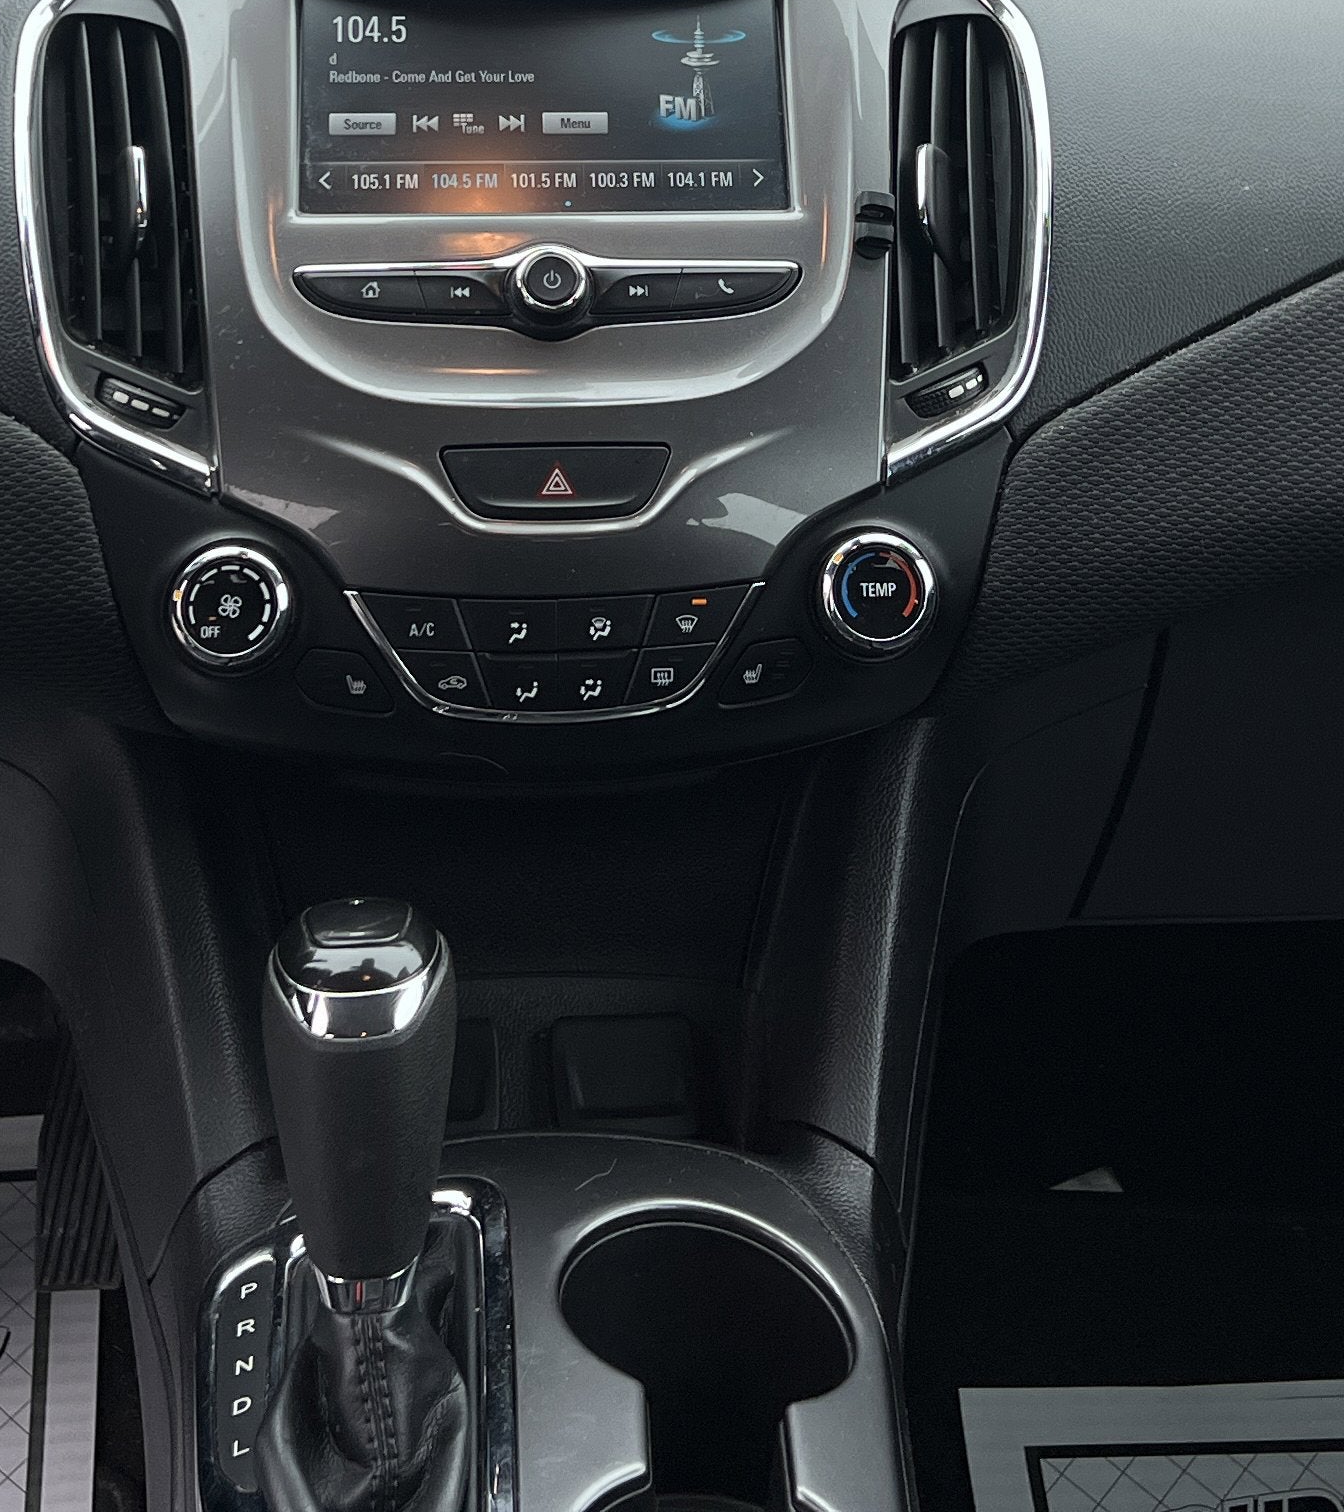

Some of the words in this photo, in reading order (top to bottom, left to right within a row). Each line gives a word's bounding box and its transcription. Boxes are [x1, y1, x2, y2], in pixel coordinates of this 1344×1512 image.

[332, 15, 408, 43] 104.5
[328, 52, 338, 65] d
[329, 70, 381, 83] Redbone
[392, 70, 426, 83] Come
[429, 70, 452, 83] And
[456, 70, 476, 83] Get
[478, 70, 505, 83] Your
[508, 70, 535, 83] Love
[659, 94, 699, 121] FM
[343, 118, 383, 130] Source
[461, 121, 485, 135] Tune
[560, 118, 592, 129] Menu
[351, 173, 392, 189] 105.1
[396, 173, 419, 189] FM
[475, 172, 498, 188] FM
[511, 172, 551, 188] 101.5
[554, 172, 577, 188] FM
[589, 171, 629, 188] 100.3
[632, 171, 656, 188] FM
[667, 171, 706, 187] 104.1
[710, 171, 734, 187] FM
[859, 582, 897, 599] TEMP
[200, 625, 221, 639] OFF
[409, 620, 435, 638] A/C
[240, 1282, 258, 1299] P
[236, 1318, 256, 1337] R
[234, 1355, 254, 1375] N
[232, 1396, 251, 1416] D
[232, 1440, 250, 1457] L
